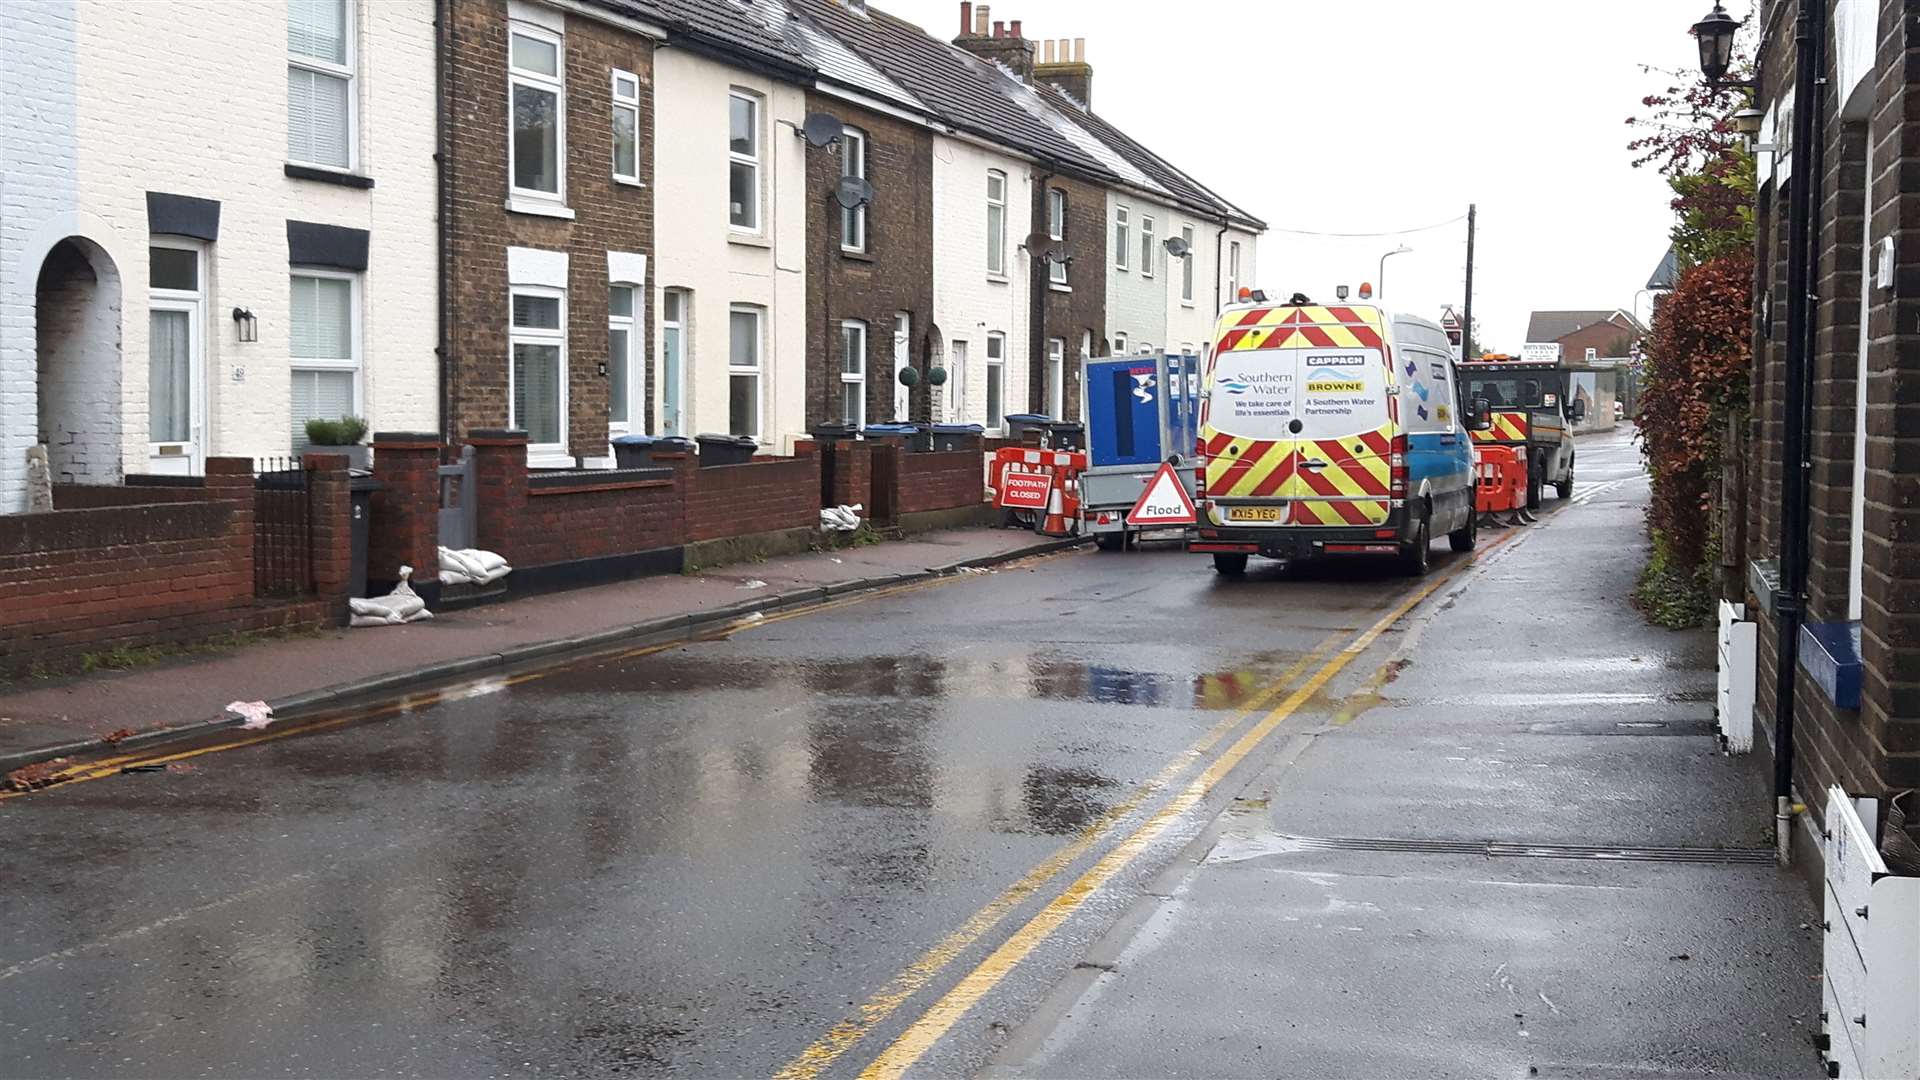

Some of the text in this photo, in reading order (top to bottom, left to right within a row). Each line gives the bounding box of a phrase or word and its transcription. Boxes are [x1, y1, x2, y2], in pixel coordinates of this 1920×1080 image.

[1308, 356, 1363, 365] CAPPACH
[1238, 372, 1293, 383] Southern
[1253, 385, 1290, 395] Water
[1308, 383, 1362, 391] BROWNE
[1235, 400, 1247, 408] We
[1248, 400, 1264, 408] take
[1235, 409, 1290, 417] life's essentials
[1305, 407, 1352, 416] Partnership
[1007, 479, 1047, 489] FOOTPATH
[1010, 489, 1041, 499] CLOSED
[1146, 504, 1181, 516] Flood
[1231, 508, 1276, 518] WX15 YEG
